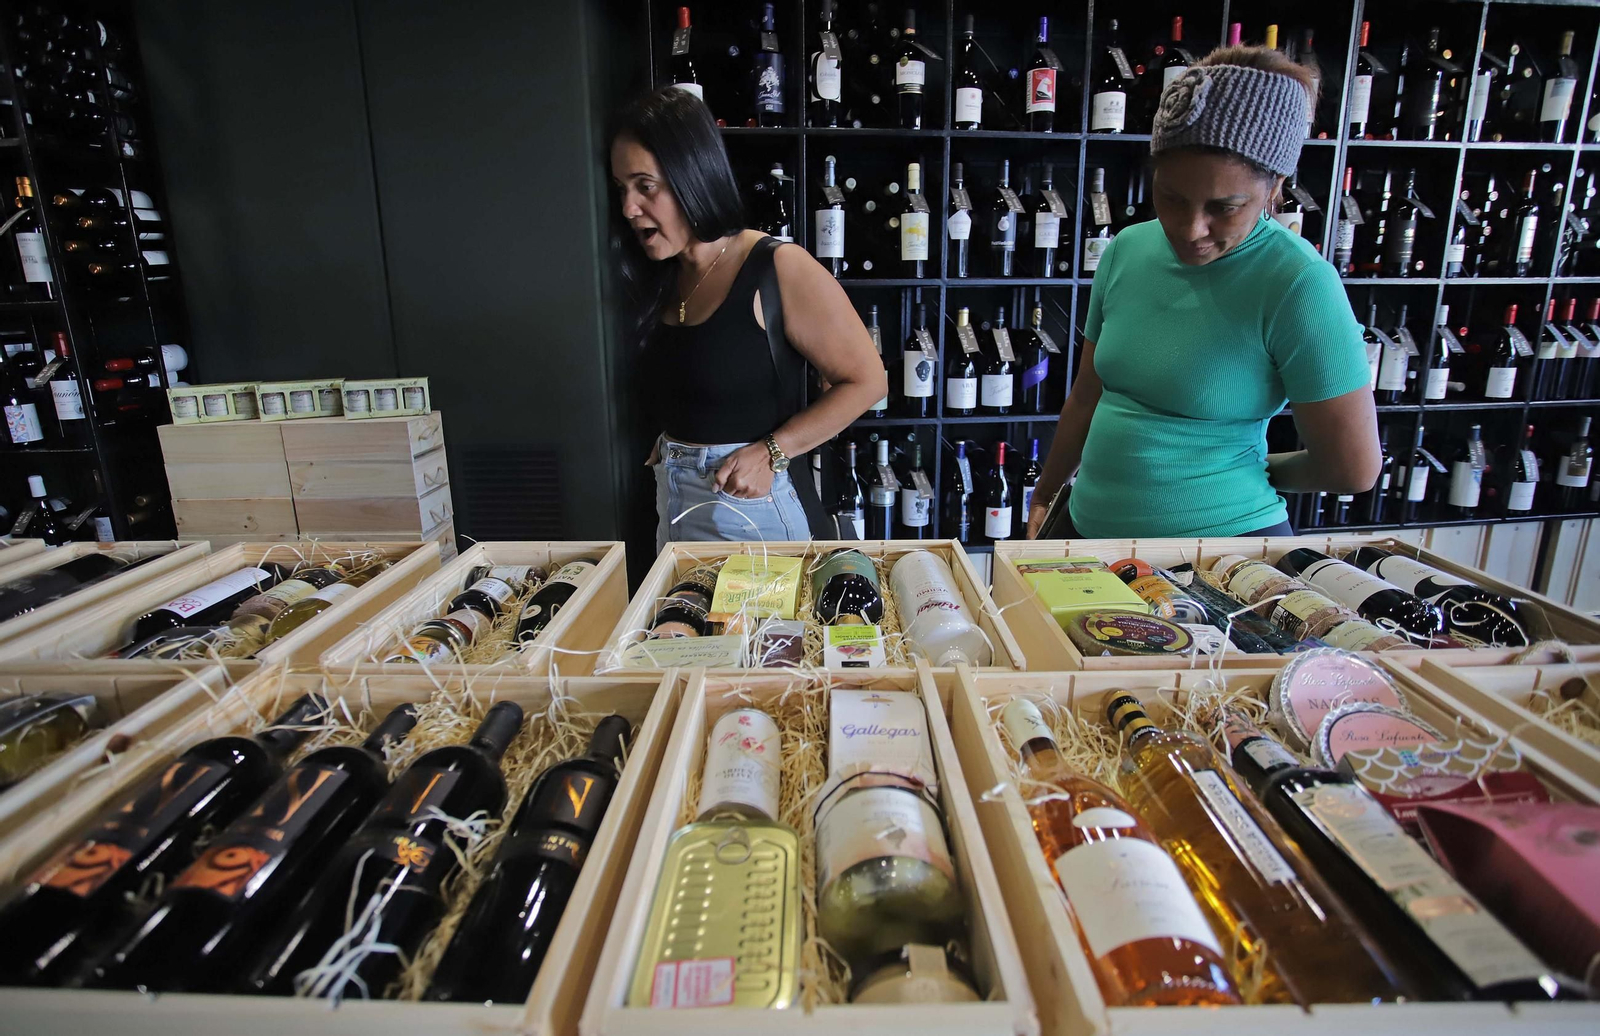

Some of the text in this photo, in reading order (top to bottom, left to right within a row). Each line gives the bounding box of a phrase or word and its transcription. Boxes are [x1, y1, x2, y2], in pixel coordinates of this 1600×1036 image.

[840, 724, 920, 739] Gallegas
[1338, 729, 1425, 745] Rosa Lafuente
